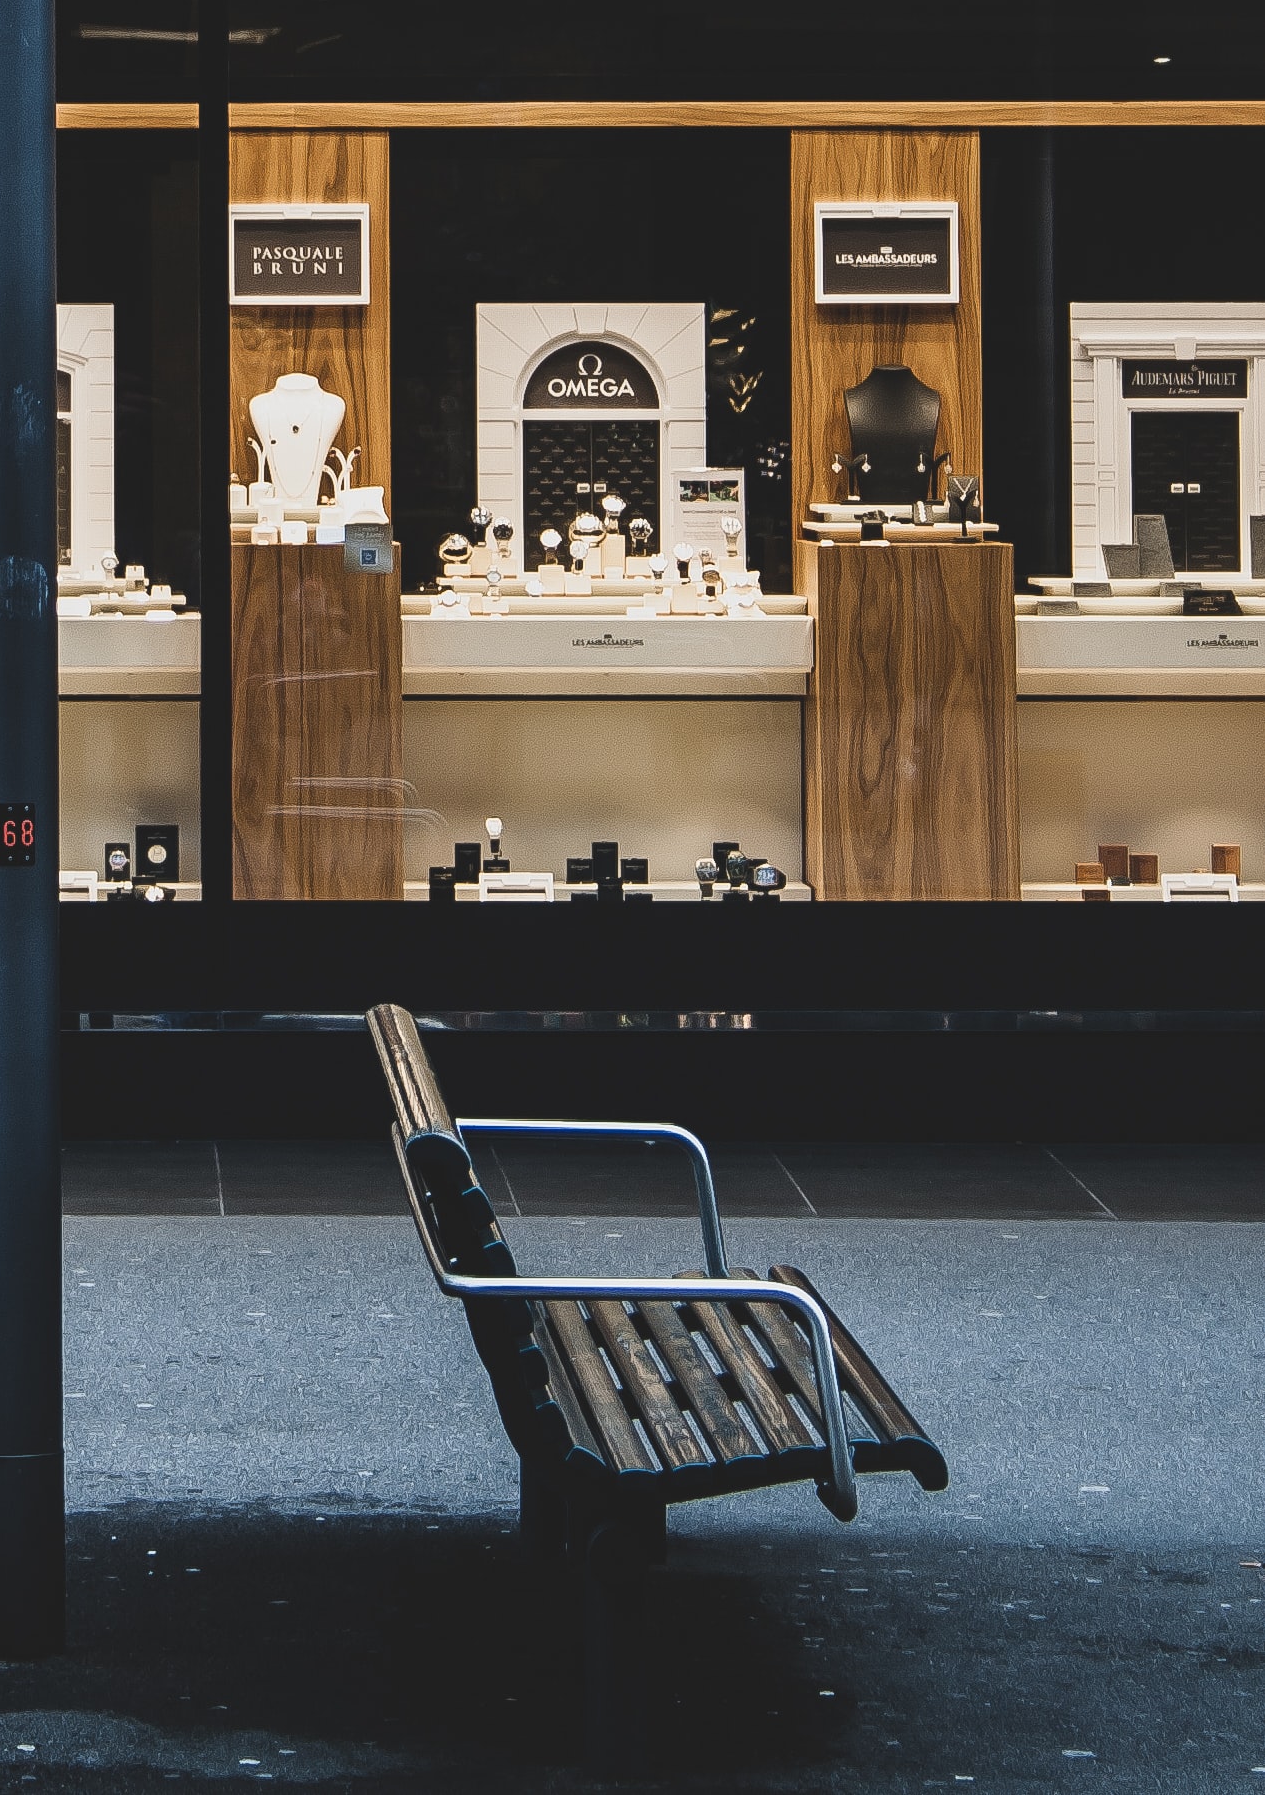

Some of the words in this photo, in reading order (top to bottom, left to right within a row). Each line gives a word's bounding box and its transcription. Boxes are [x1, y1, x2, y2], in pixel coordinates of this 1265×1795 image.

[253, 246, 344, 262] PASQUALE
[835, 253, 854, 265] LES
[855, 253, 938, 265] AMBASSADEURS
[253, 261, 344, 275] BRUNI
[1131, 370, 1195, 387] AUDEMARS
[1197, 370, 1238, 387] PIGUET
[547, 377, 635, 398] OMEGA
